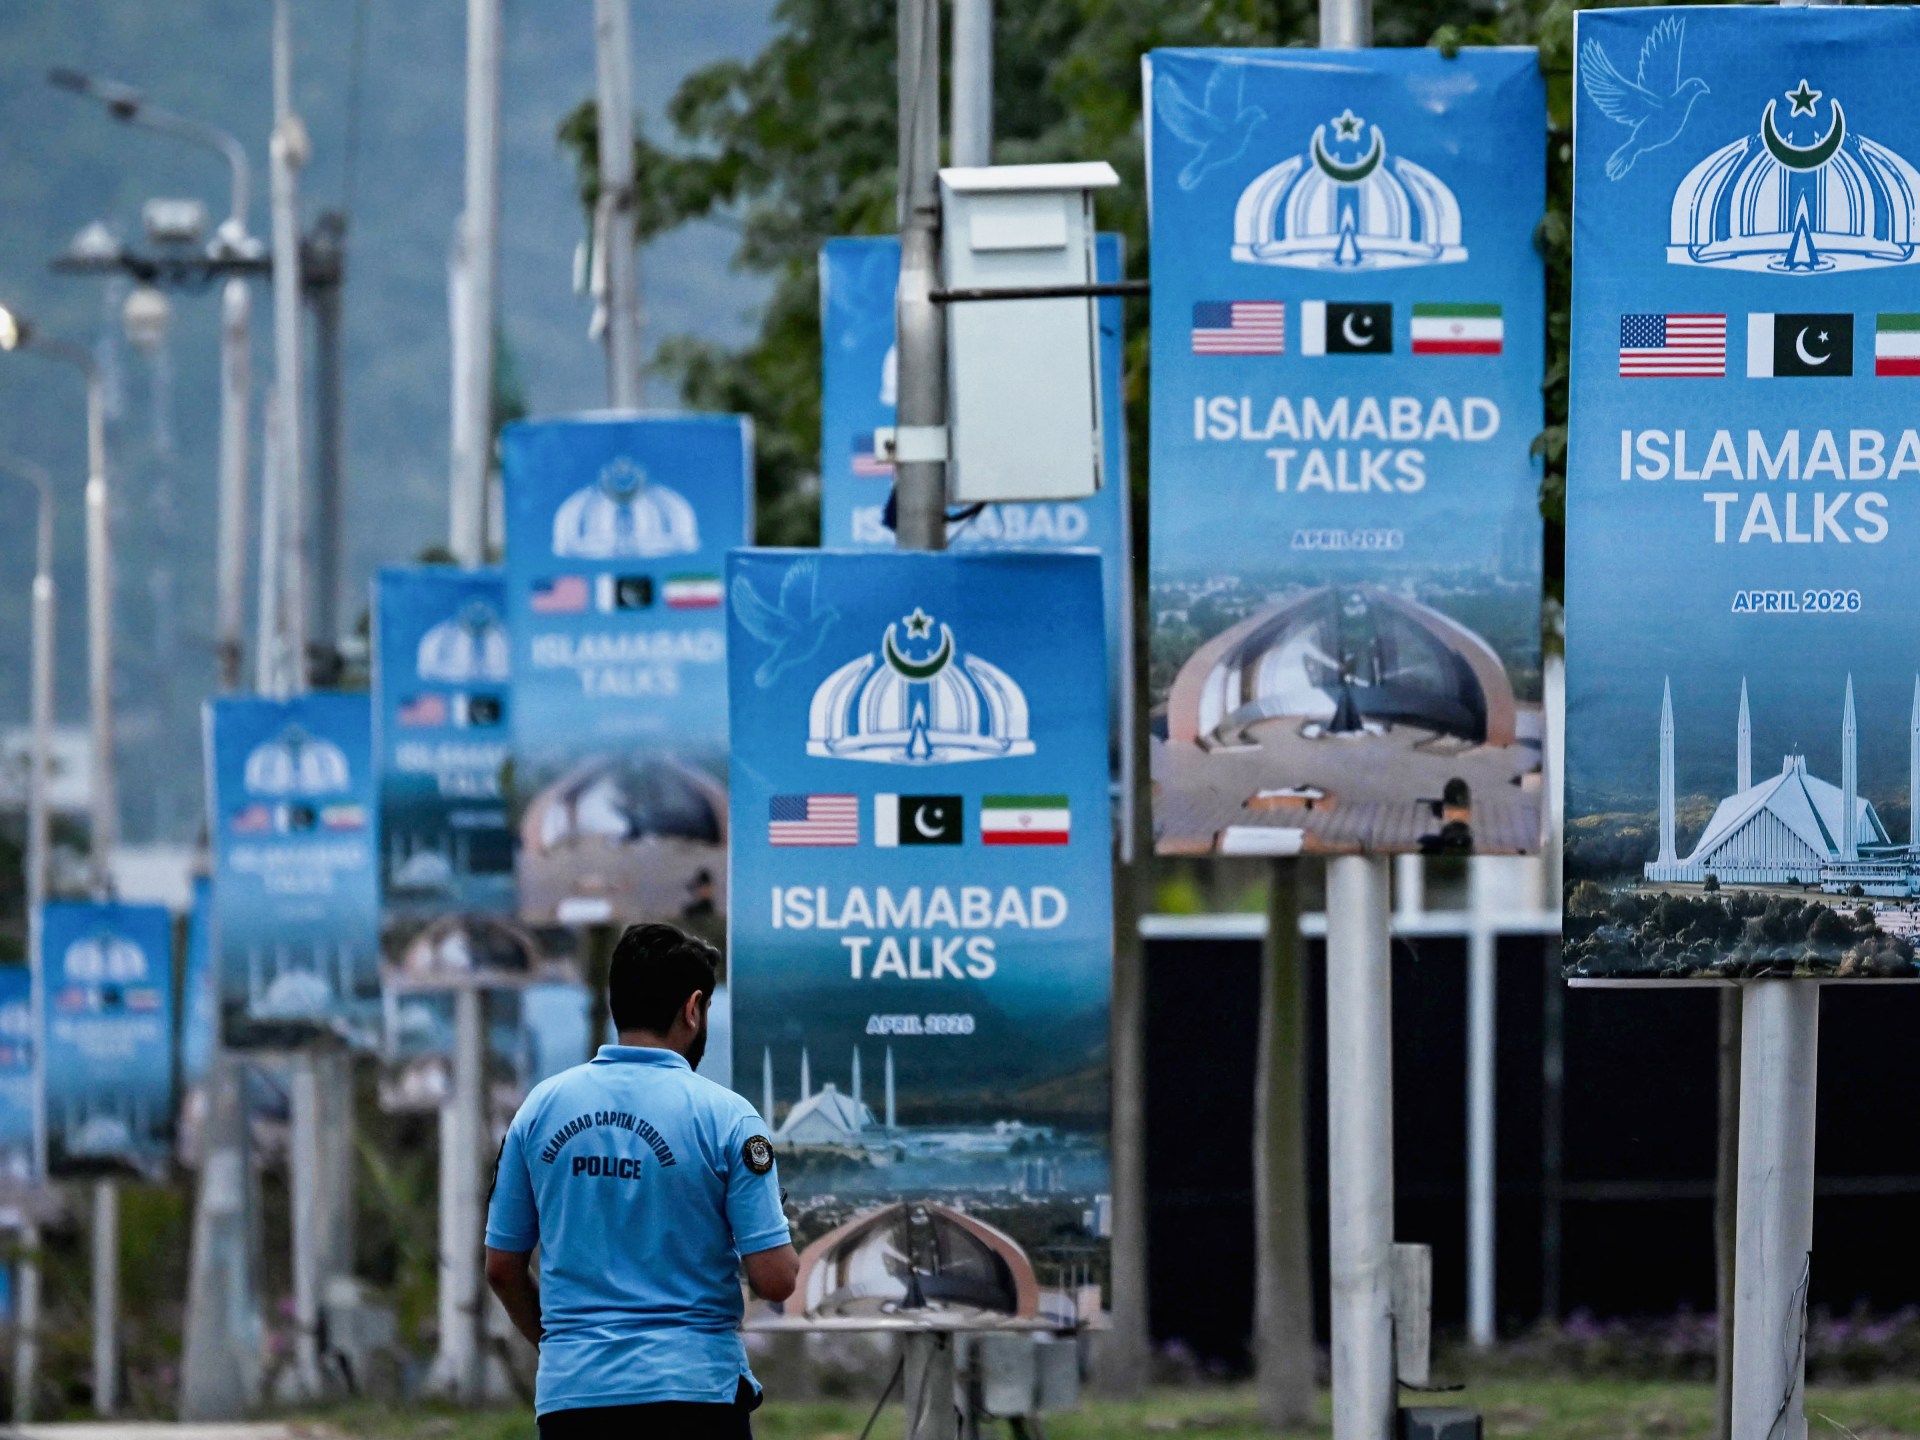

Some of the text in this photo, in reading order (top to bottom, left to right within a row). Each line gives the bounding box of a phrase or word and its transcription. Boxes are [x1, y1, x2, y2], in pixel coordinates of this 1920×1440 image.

[1194, 397, 1500, 441] ISLAMABAD
[1266, 448, 1427, 493] TALKS
[1703, 492, 1889, 543] TALKS
[1732, 590, 1861, 612] APRIL 2026
[771, 886, 1068, 929] ISLAMABAD
[841, 936, 997, 979] TALKS
[866, 1014, 975, 1034] APRIL 2026
[541, 1111, 677, 1168] ISLAMABAD CAPITAL TERRITORY
[572, 1156, 641, 1180] POLICE
